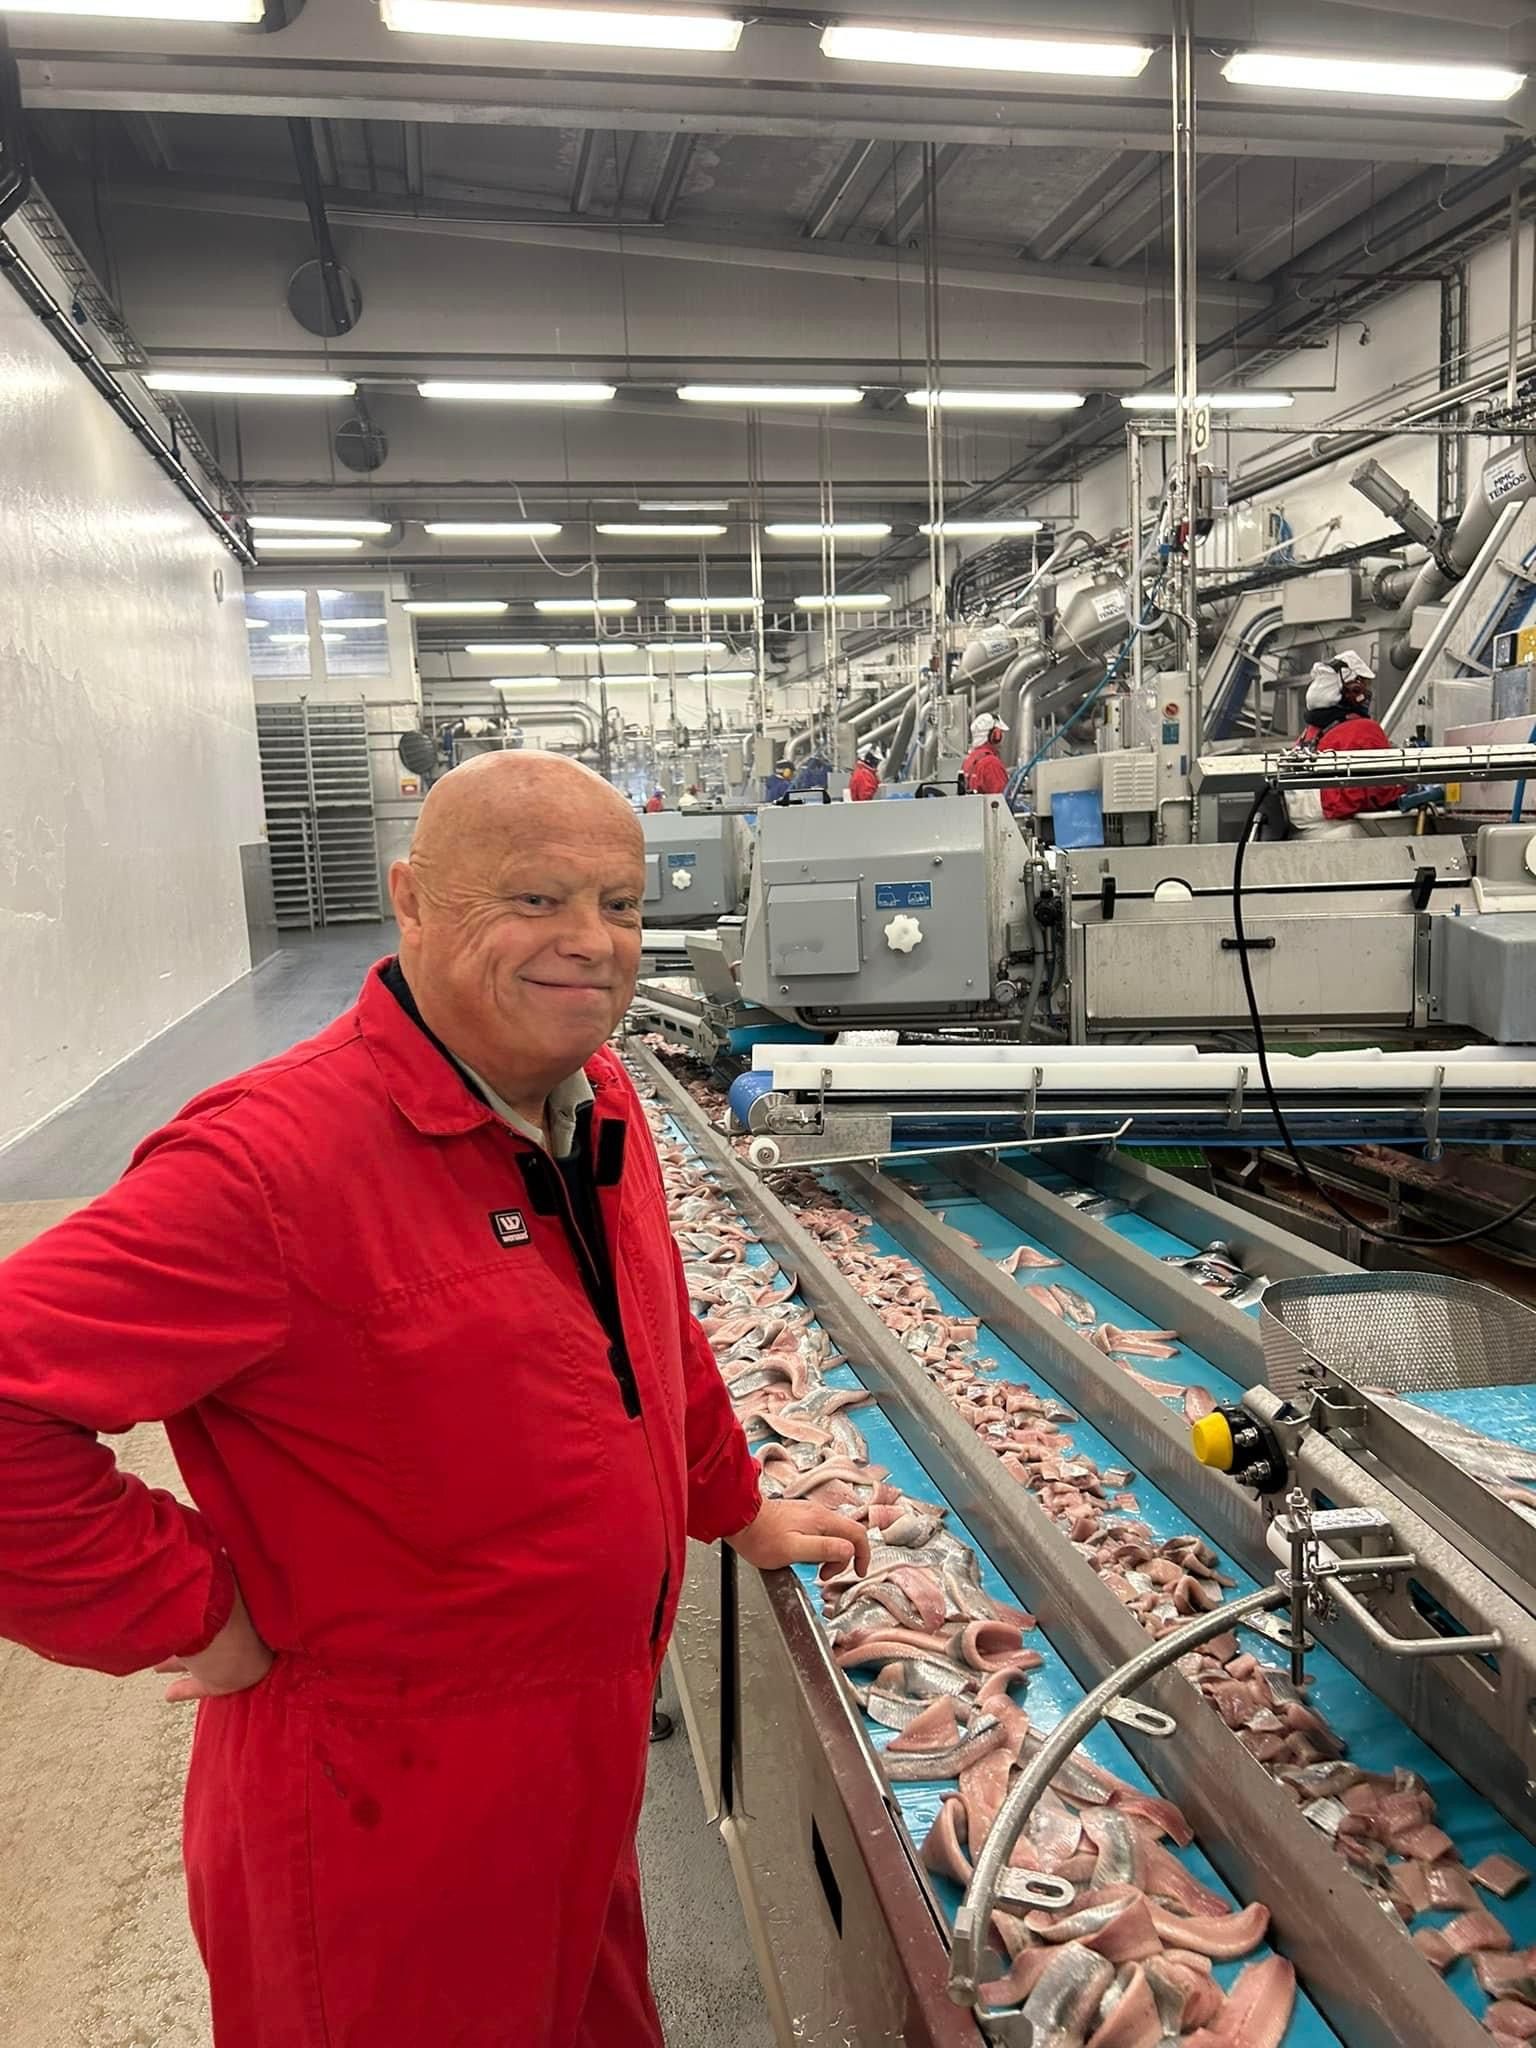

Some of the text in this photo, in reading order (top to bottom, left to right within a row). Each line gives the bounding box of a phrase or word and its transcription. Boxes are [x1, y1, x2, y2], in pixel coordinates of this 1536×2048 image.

[1195, 409, 1207, 448] 8
[1488, 473, 1527, 501] TENDOS
[1494, 470, 1515, 488] MMC
